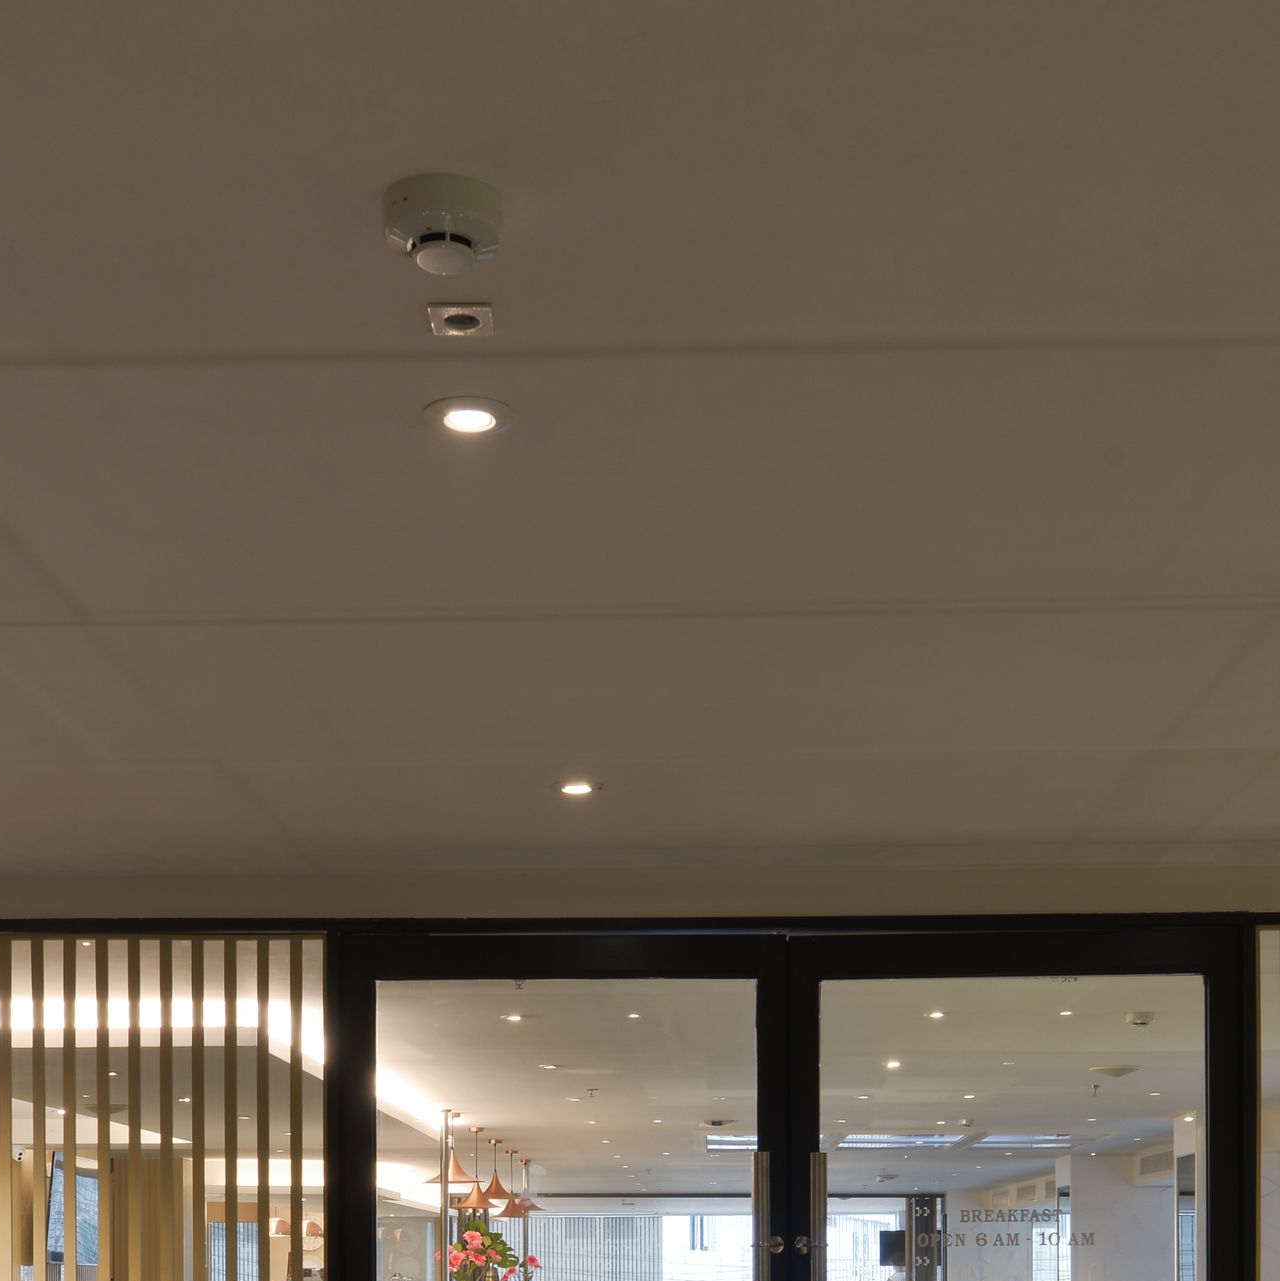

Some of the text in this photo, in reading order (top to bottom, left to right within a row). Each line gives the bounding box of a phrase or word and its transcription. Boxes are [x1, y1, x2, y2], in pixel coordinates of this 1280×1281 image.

[959, 1208, 1063, 1223] BREAKFAST
[917, 1232, 966, 1248] OPEN
[975, 1232, 988, 1247] 6
[992, 1232, 1021, 1247] AM
[1039, 1232, 1061, 1247] 10
[1068, 1232, 1097, 1247] AM
